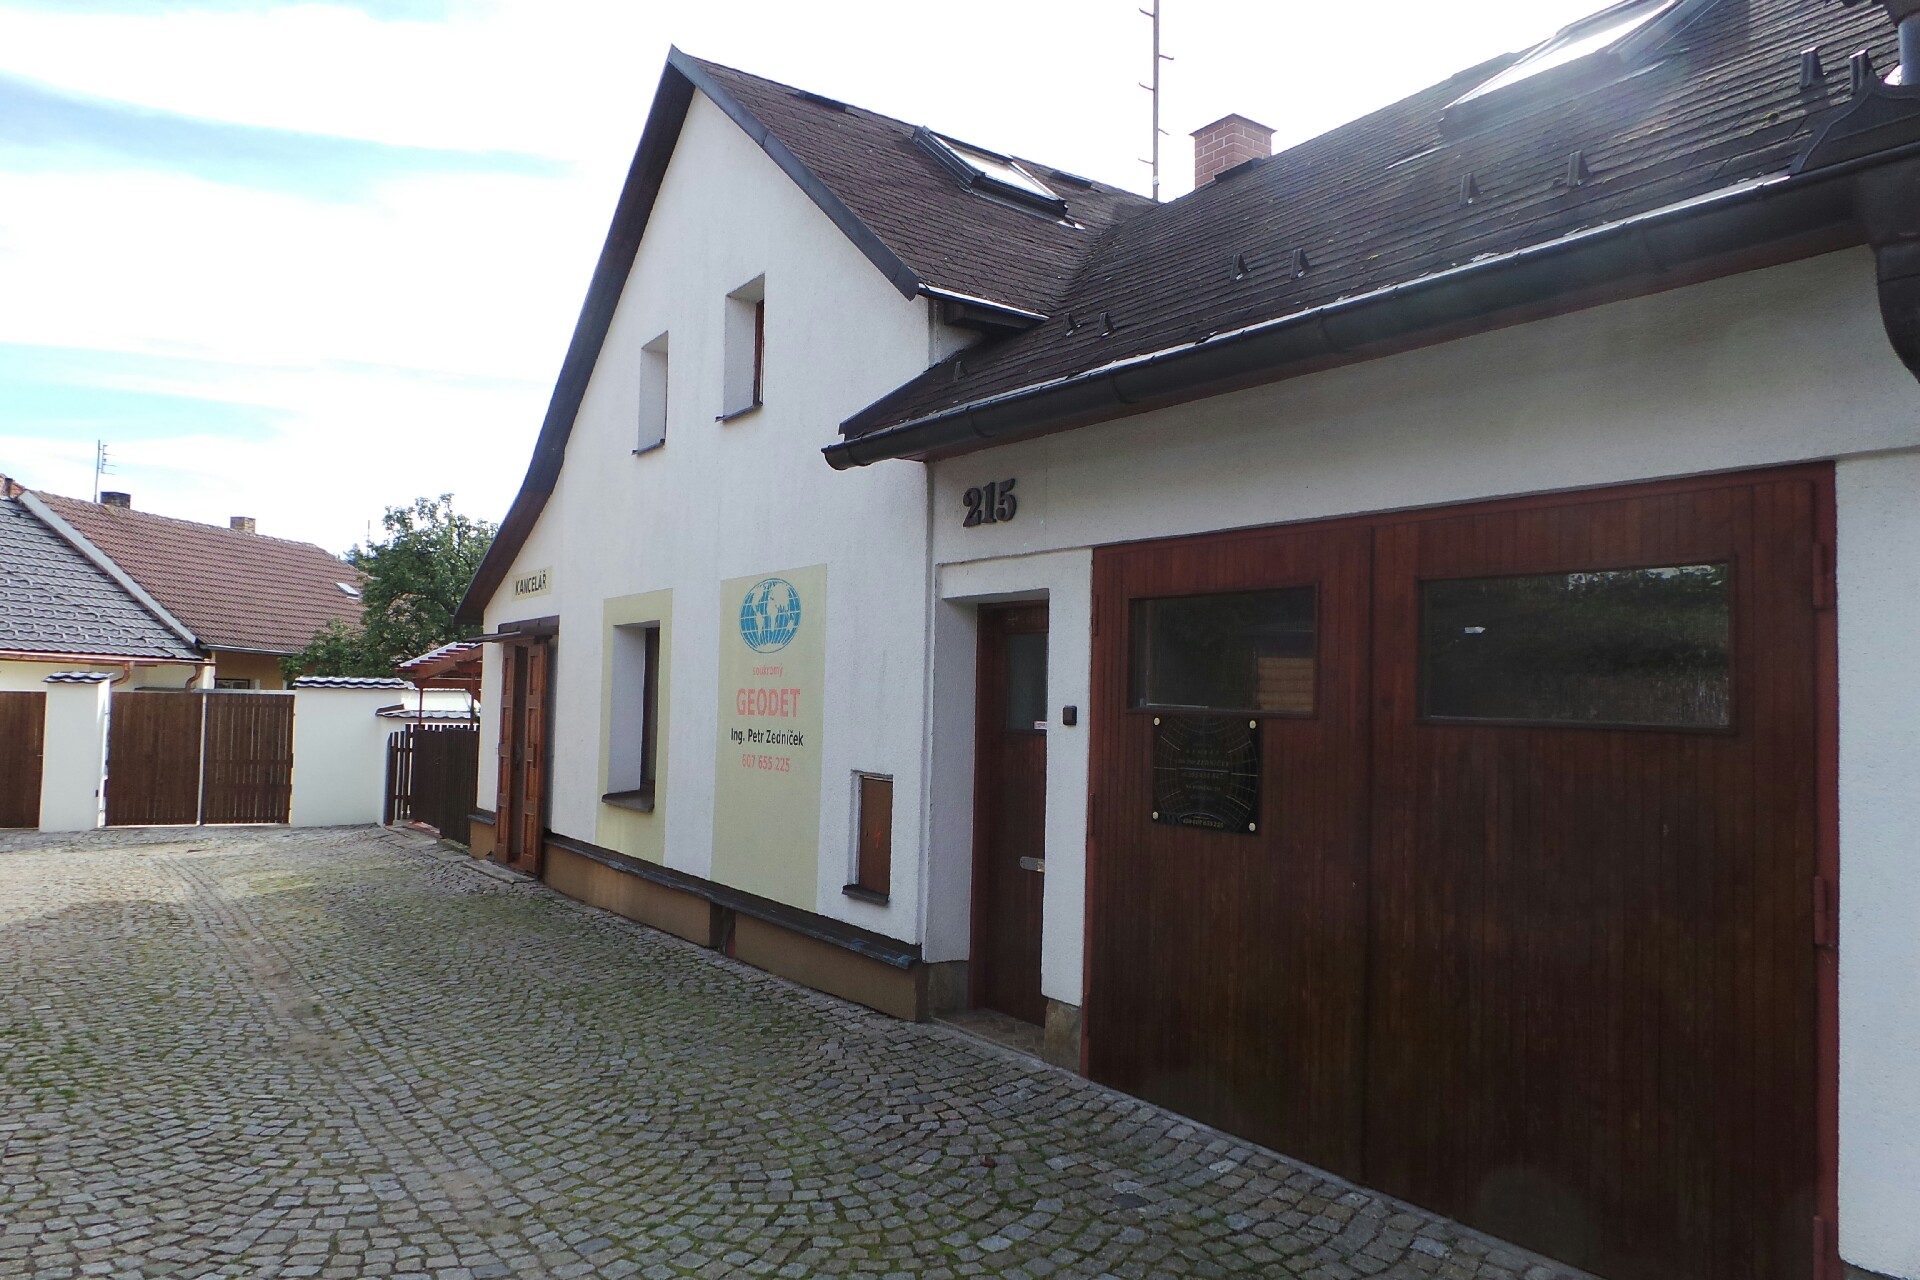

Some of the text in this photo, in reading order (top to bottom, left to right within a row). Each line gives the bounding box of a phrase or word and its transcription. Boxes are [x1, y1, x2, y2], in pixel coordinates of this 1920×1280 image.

[962, 478, 1017, 528] 215
[515, 570, 546, 595] KANCELÁŘ
[752, 663, 783, 677] soukromý
[737, 688, 800, 718] GEODET
[731, 727, 803, 746] Ing. Petr Zedníček
[742, 753, 791, 773] 607 655 225
